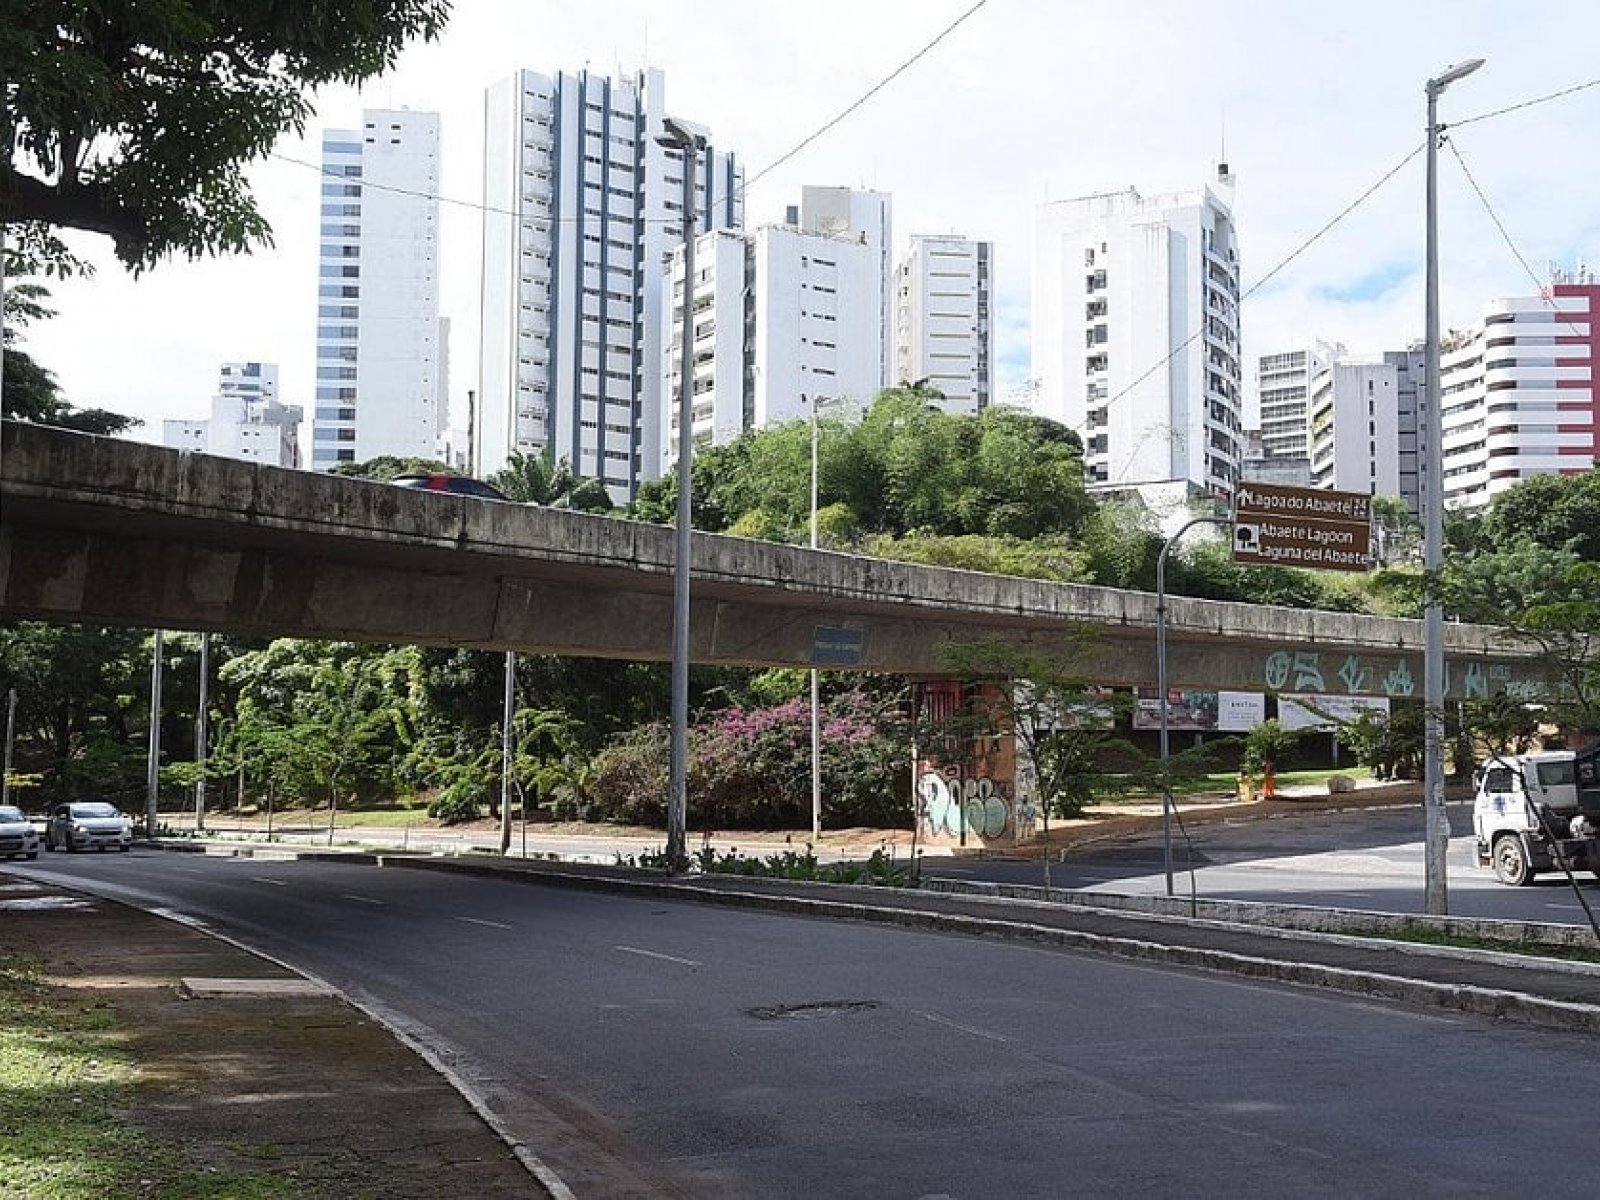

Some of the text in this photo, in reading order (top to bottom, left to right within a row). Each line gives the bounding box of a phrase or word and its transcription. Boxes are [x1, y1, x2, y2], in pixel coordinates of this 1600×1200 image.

[1248, 491, 1286, 509] Lagoa
[1287, 496, 1303, 509] do
[1307, 526, 1353, 545] Lagoon
[1258, 544, 1302, 560] Laguna
[1303, 548, 1322, 561] del
